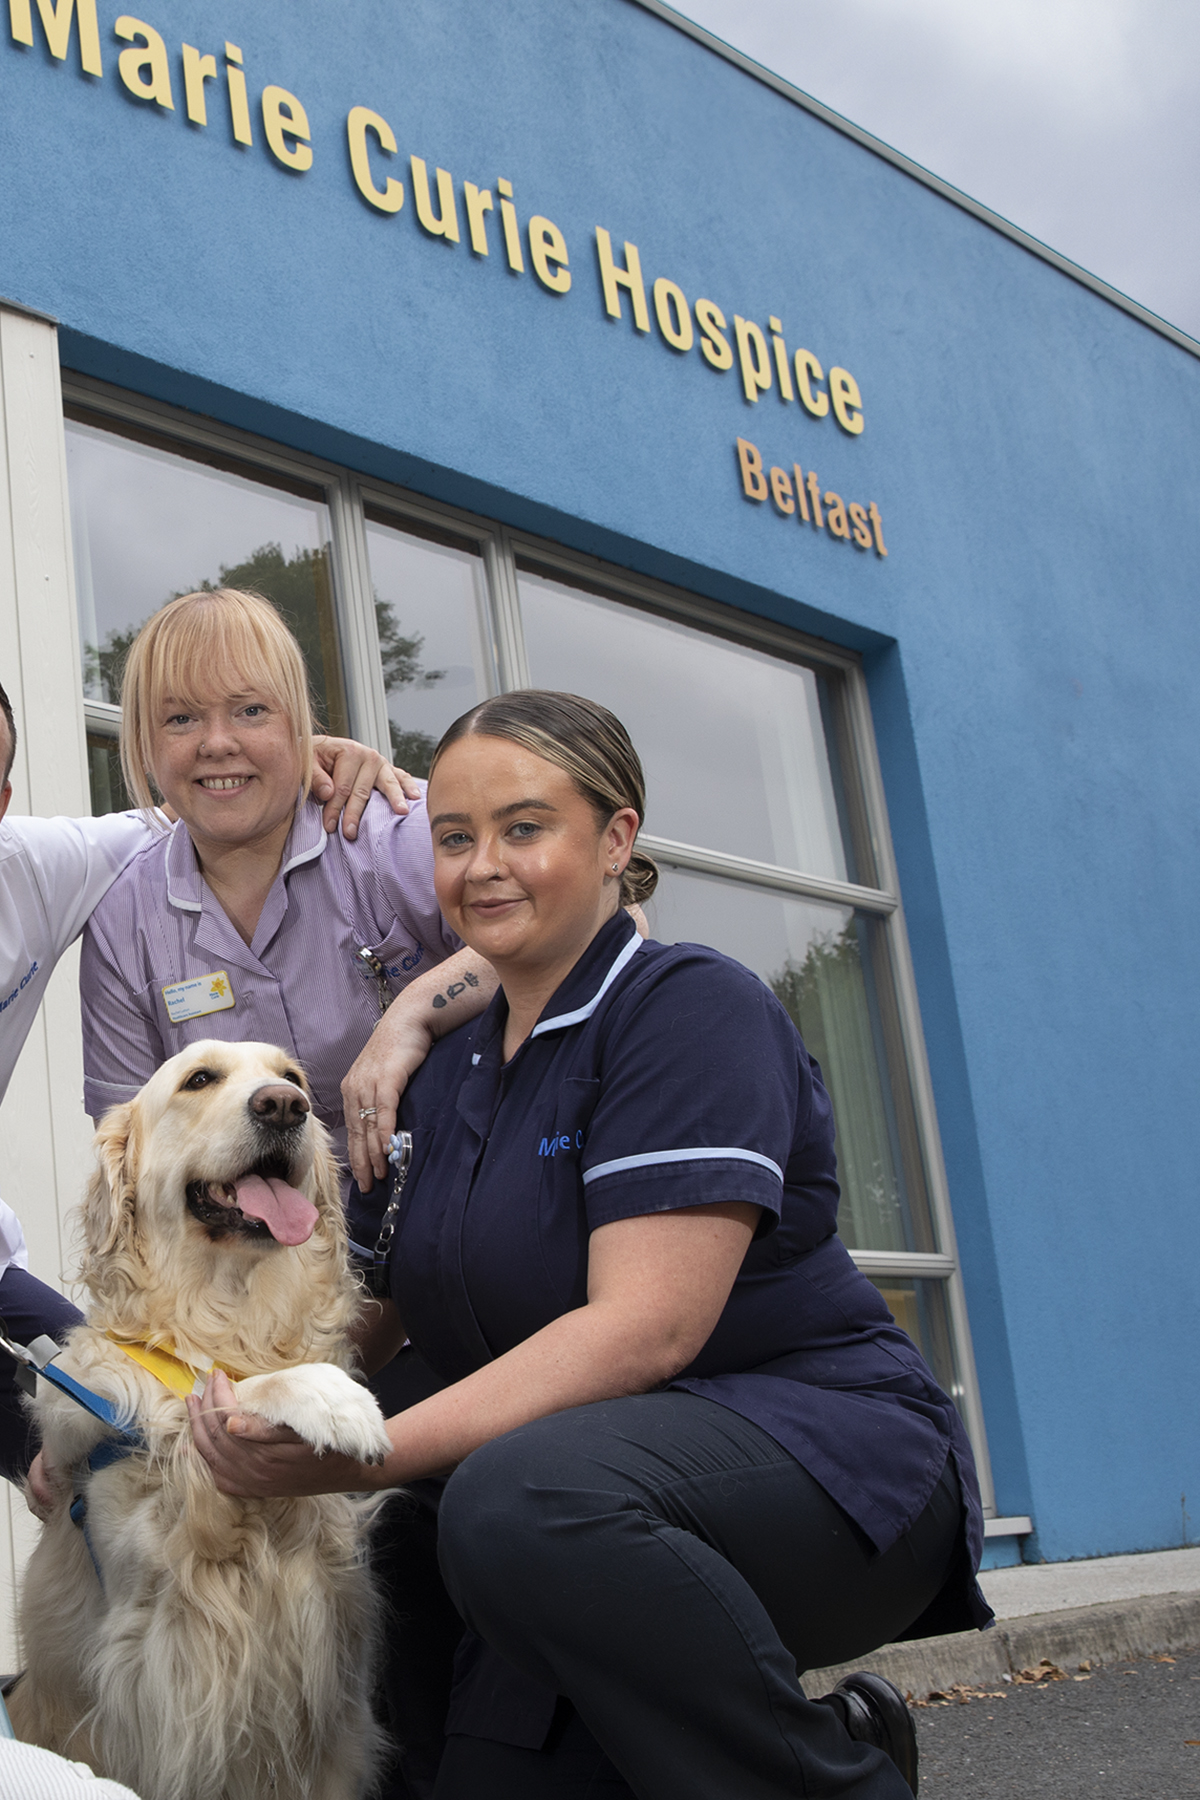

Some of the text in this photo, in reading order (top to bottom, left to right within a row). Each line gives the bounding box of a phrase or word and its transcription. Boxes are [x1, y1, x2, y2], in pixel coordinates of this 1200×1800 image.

[8, 0, 865, 436] Marie Curie Hospice
[736, 437, 888, 558] Belfast
[167, 997, 186, 1006] Rachel
[538, 1131, 570, 1157] Mie
